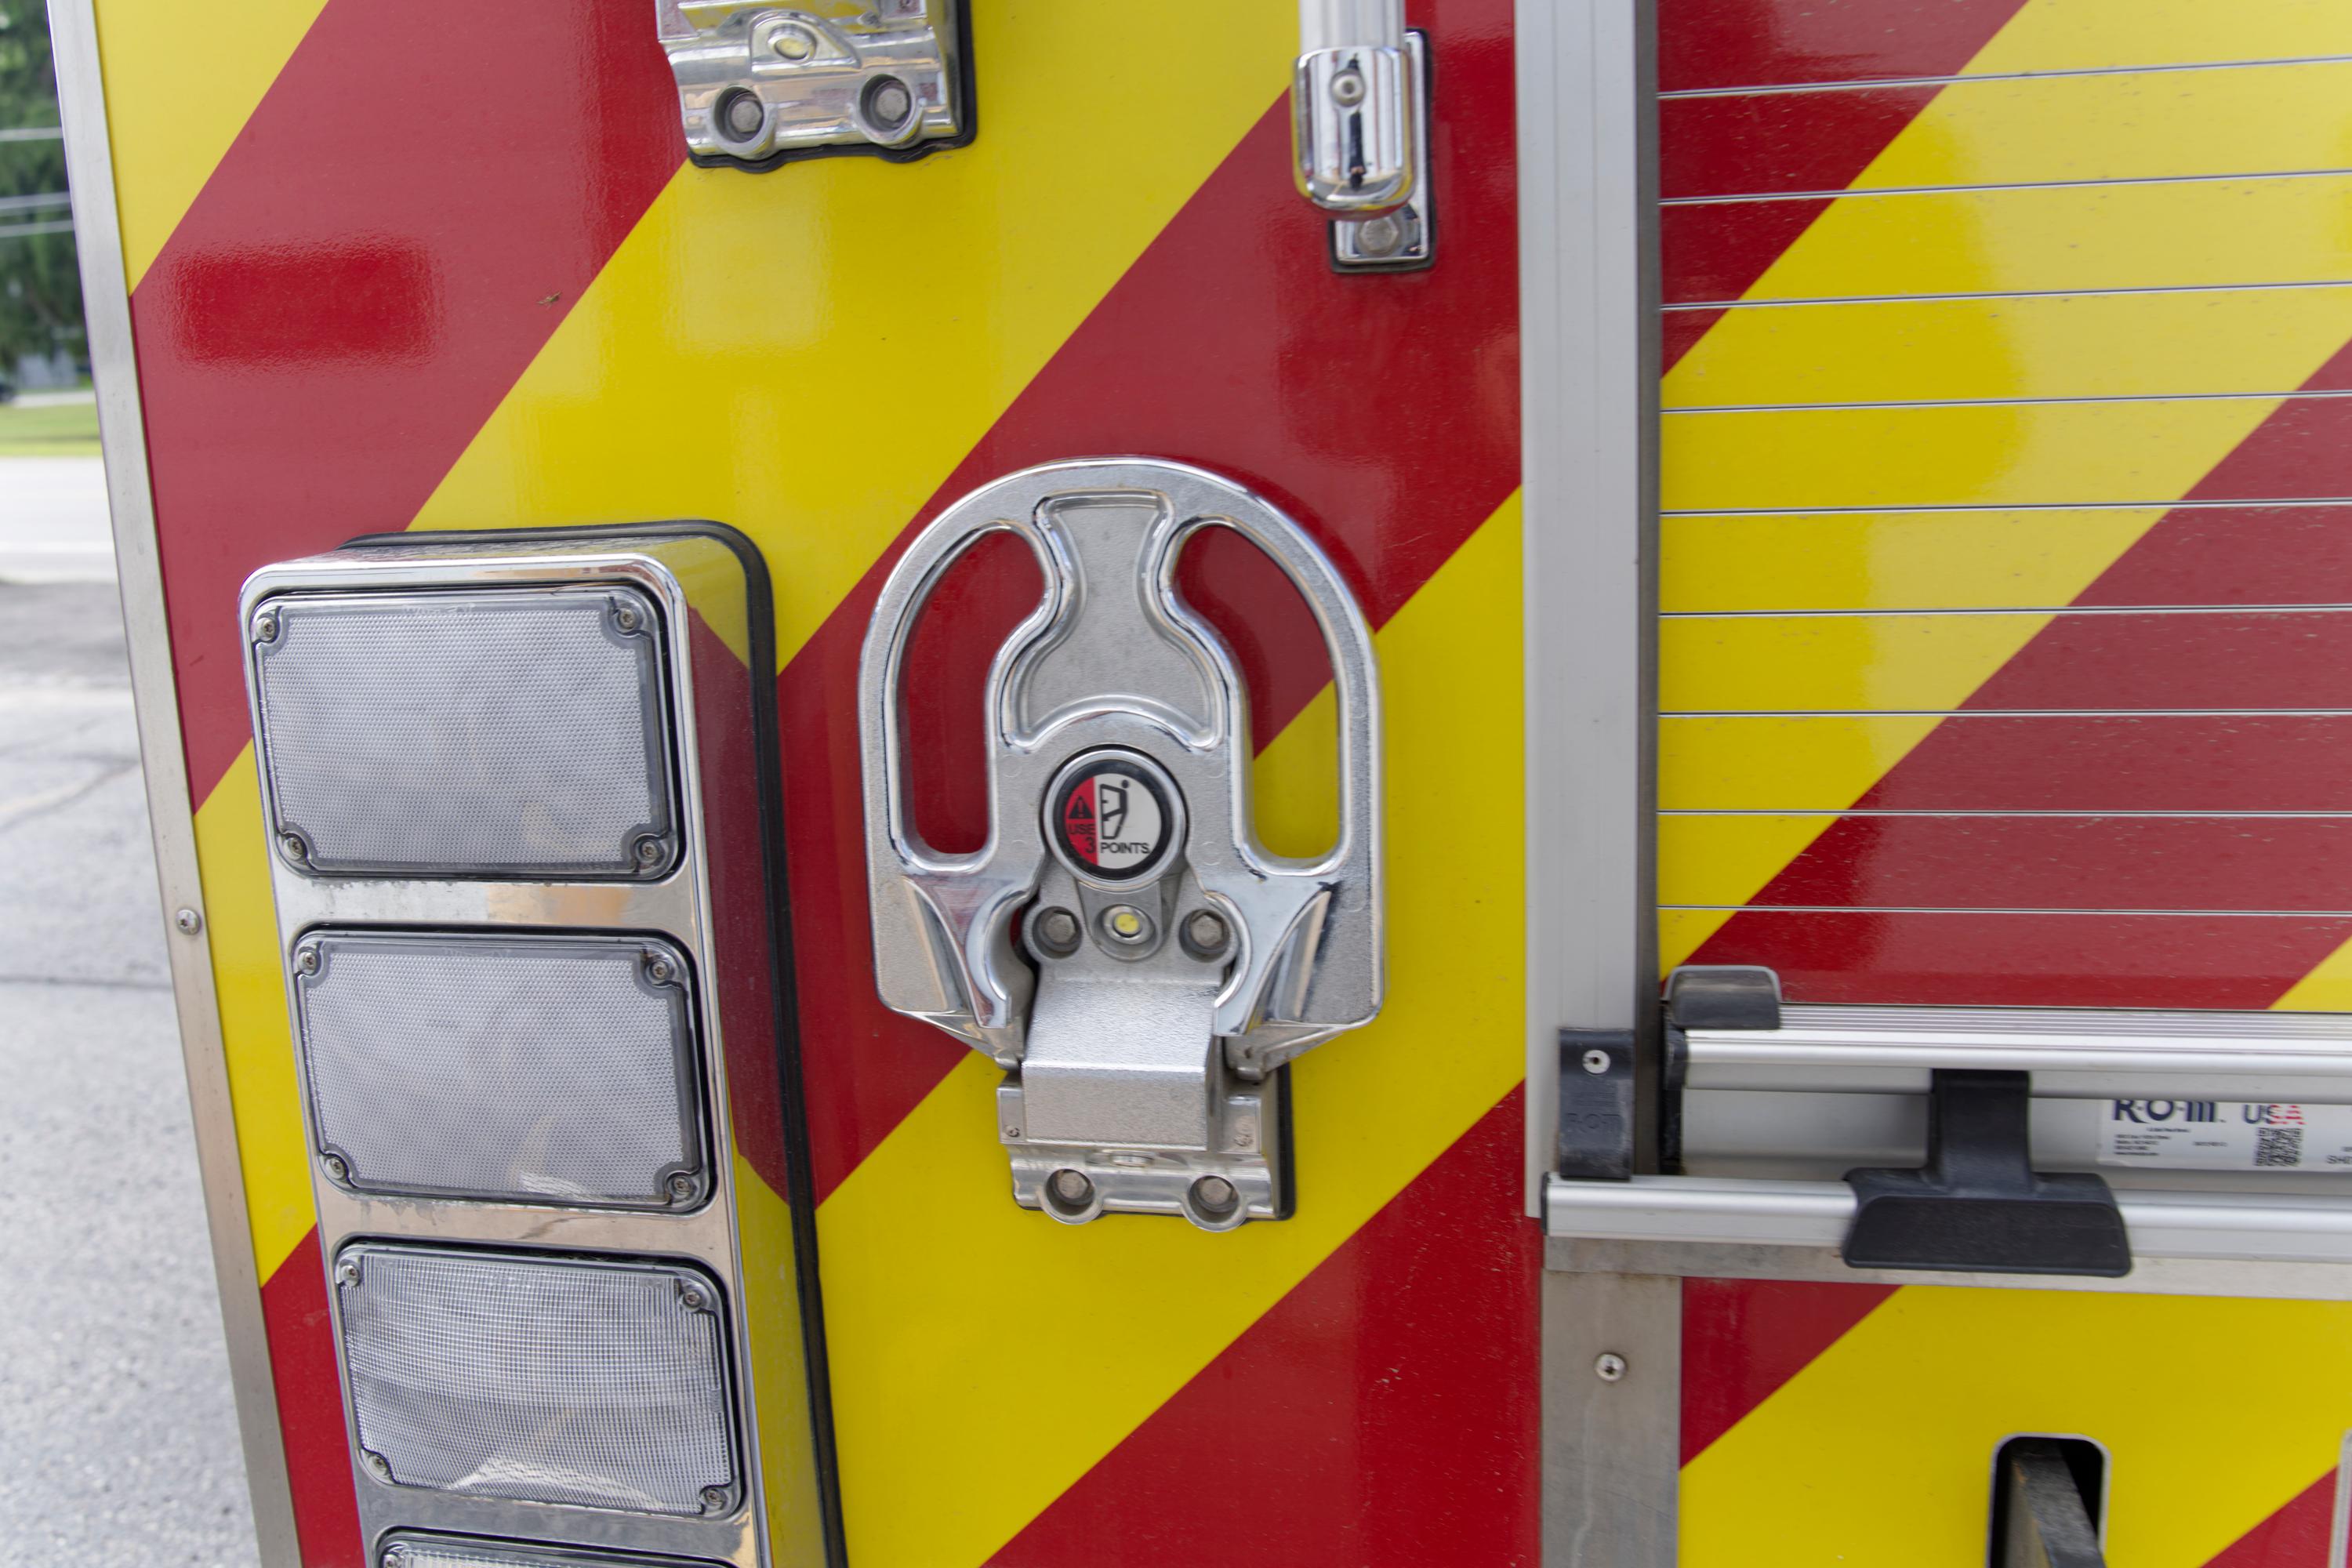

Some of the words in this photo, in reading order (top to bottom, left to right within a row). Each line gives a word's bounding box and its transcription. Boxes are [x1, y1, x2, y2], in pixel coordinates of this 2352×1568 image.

[1068, 824, 1095, 835] USE
[1085, 837, 1096, 854] 3
[1100, 842, 1149, 854] POINTS
